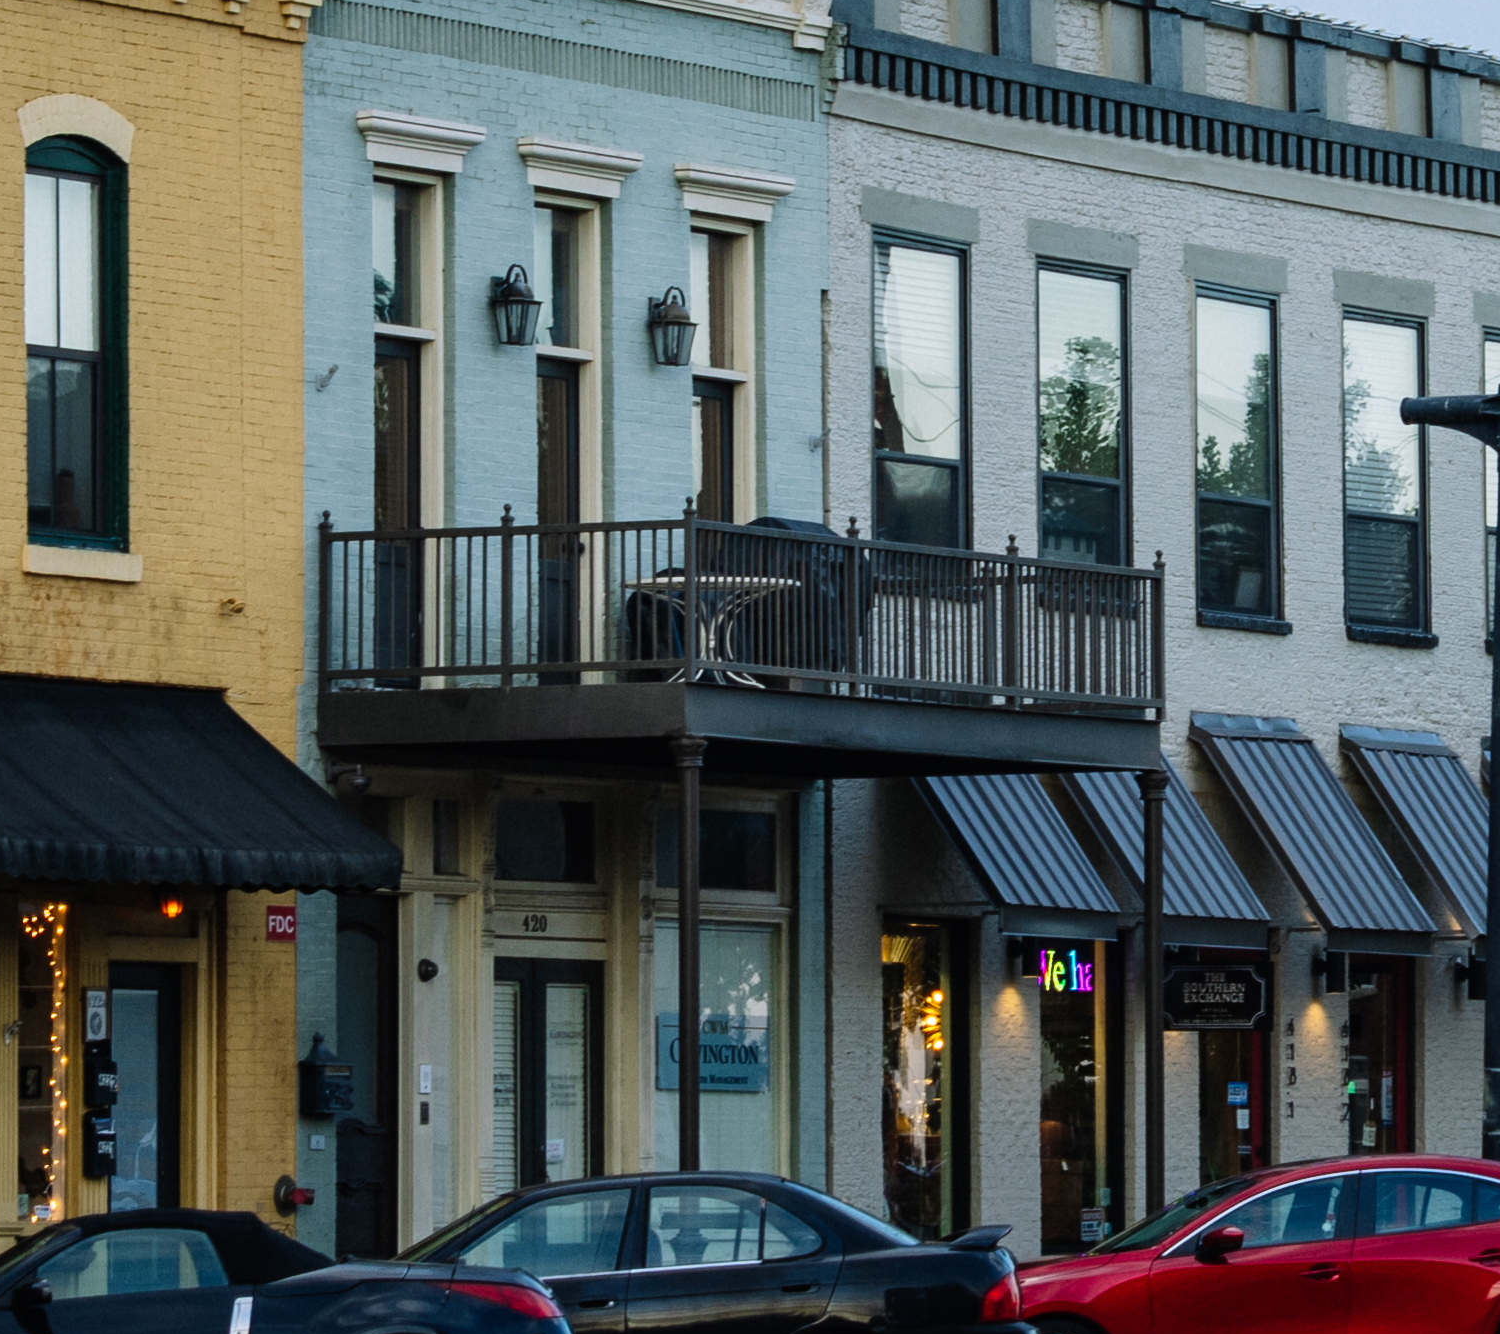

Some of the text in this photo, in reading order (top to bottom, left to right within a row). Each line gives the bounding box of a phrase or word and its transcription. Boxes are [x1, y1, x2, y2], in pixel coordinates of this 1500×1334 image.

[268, 915, 295, 934] FDC
[522, 914, 548, 933] 420
[1204, 972, 1226, 982] THE
[1183, 982, 1247, 993] SOUTHERN
[1184, 993, 1246, 1004] EXCHANGE
[702, 1019, 729, 1035] CWM
[669, 1037, 760, 1066] CINGTON
